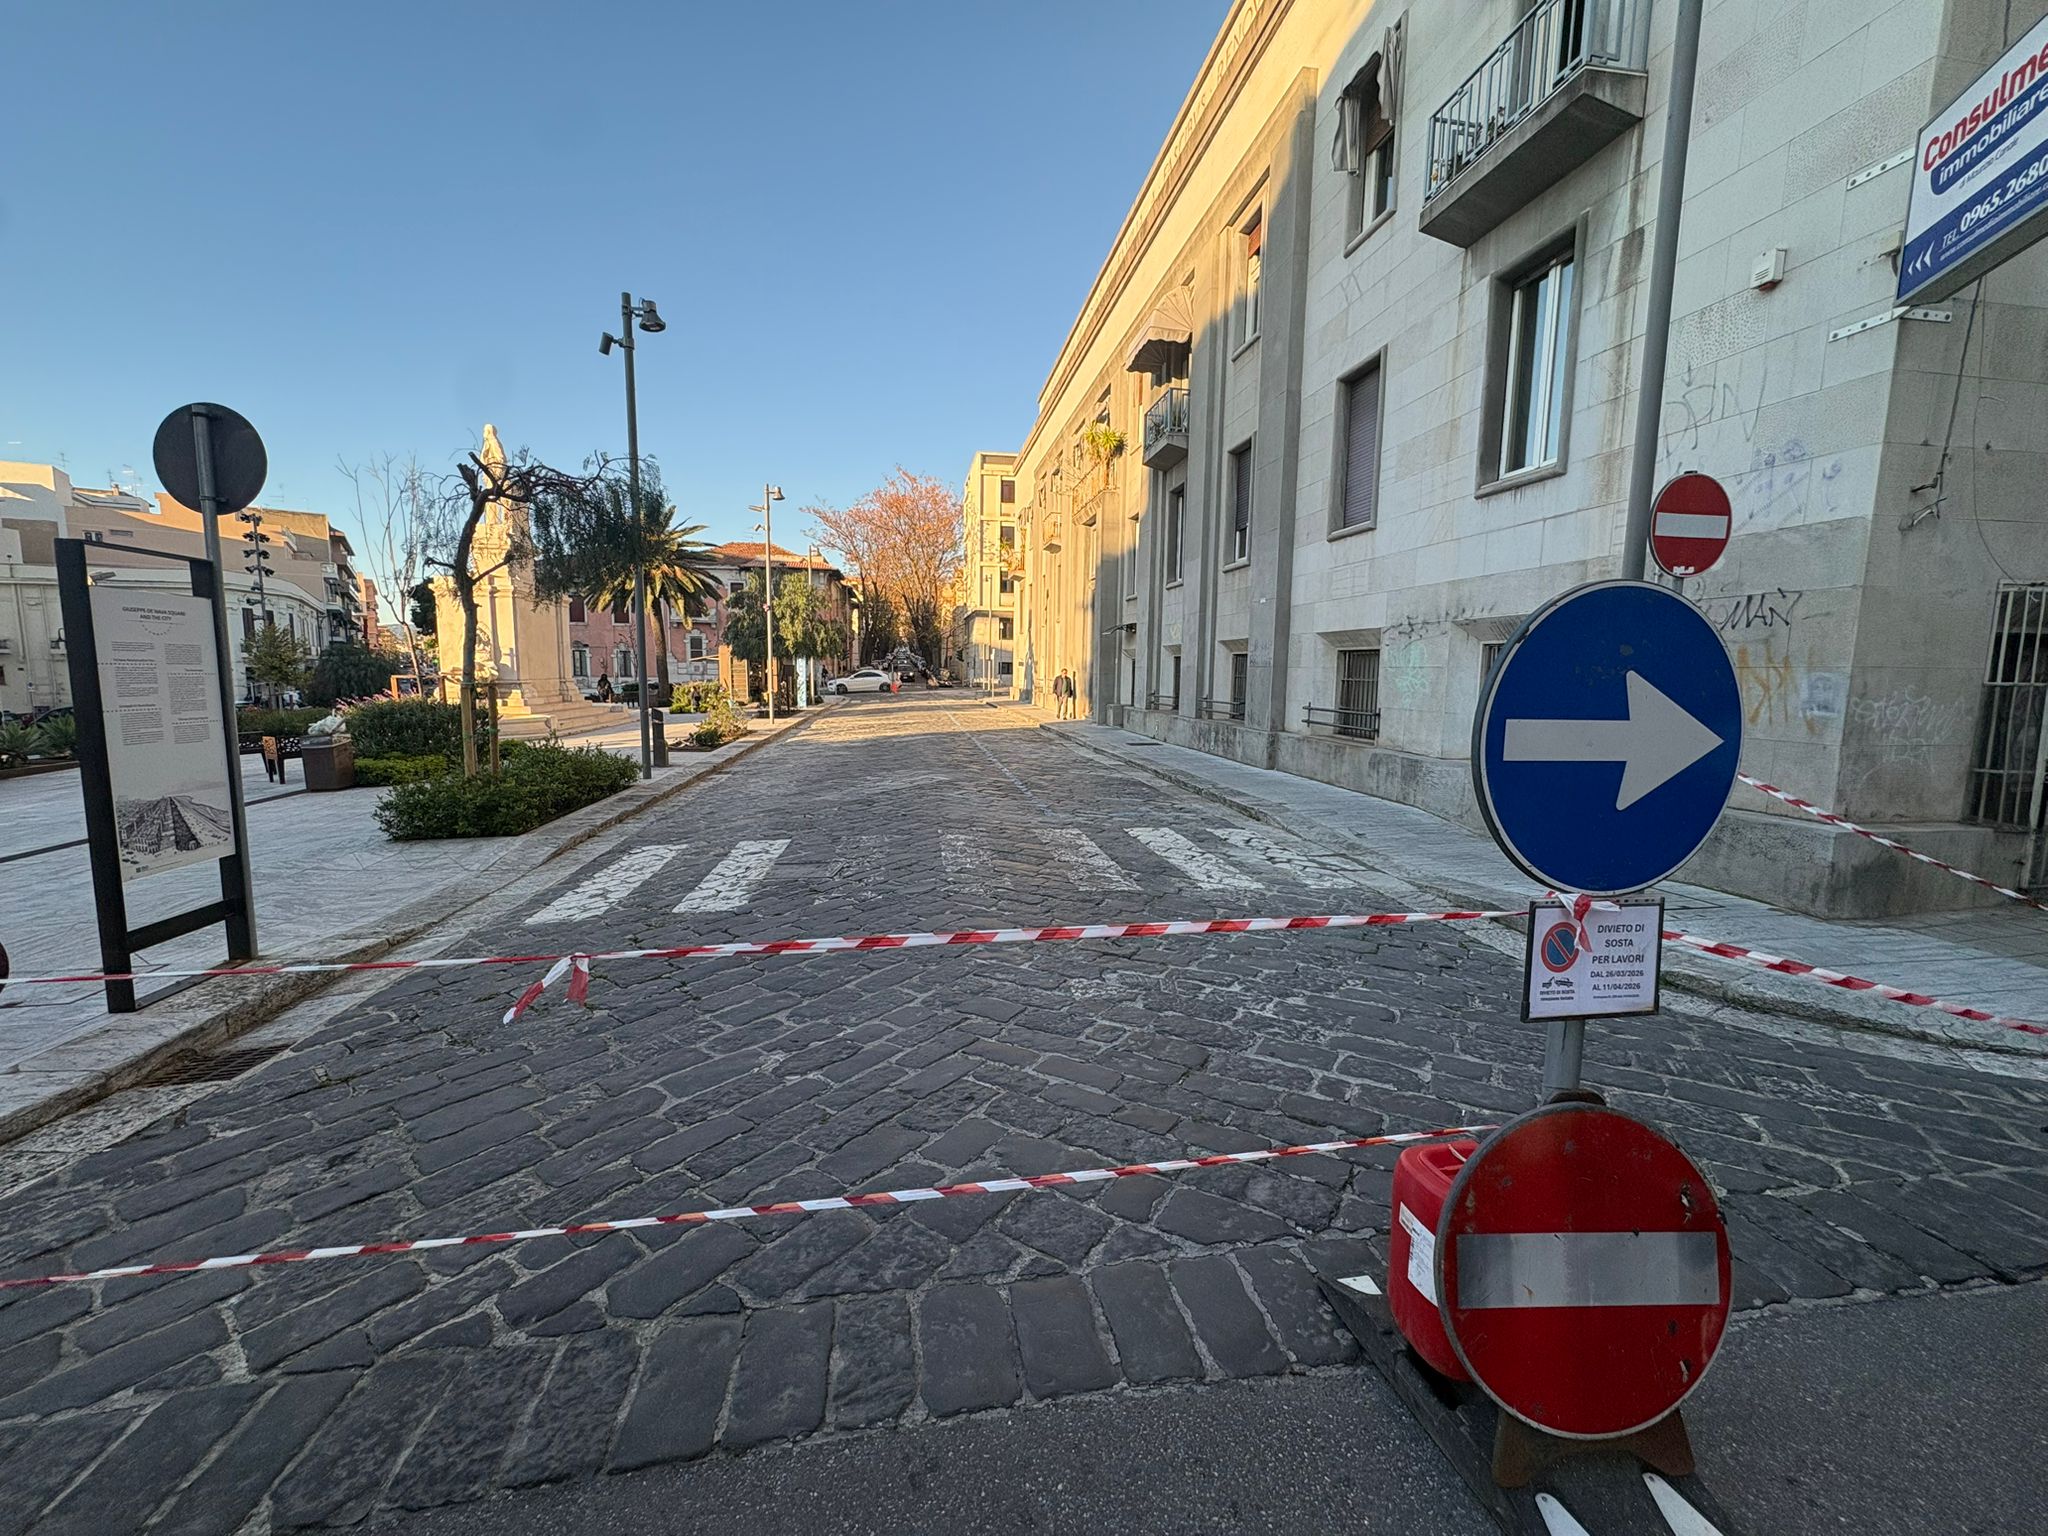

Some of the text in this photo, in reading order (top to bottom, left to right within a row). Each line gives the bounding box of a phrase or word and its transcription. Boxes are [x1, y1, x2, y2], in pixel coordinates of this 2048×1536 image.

[1938, 83, 2048, 186] immobiliare
[1597, 924, 1645, 933] DIVIETO DI
[1604, 939, 1634, 948] SOSTA
[1591, 954, 1645, 964] PER LAVORI
[1602, 983, 1641, 991] 11/04/2026
